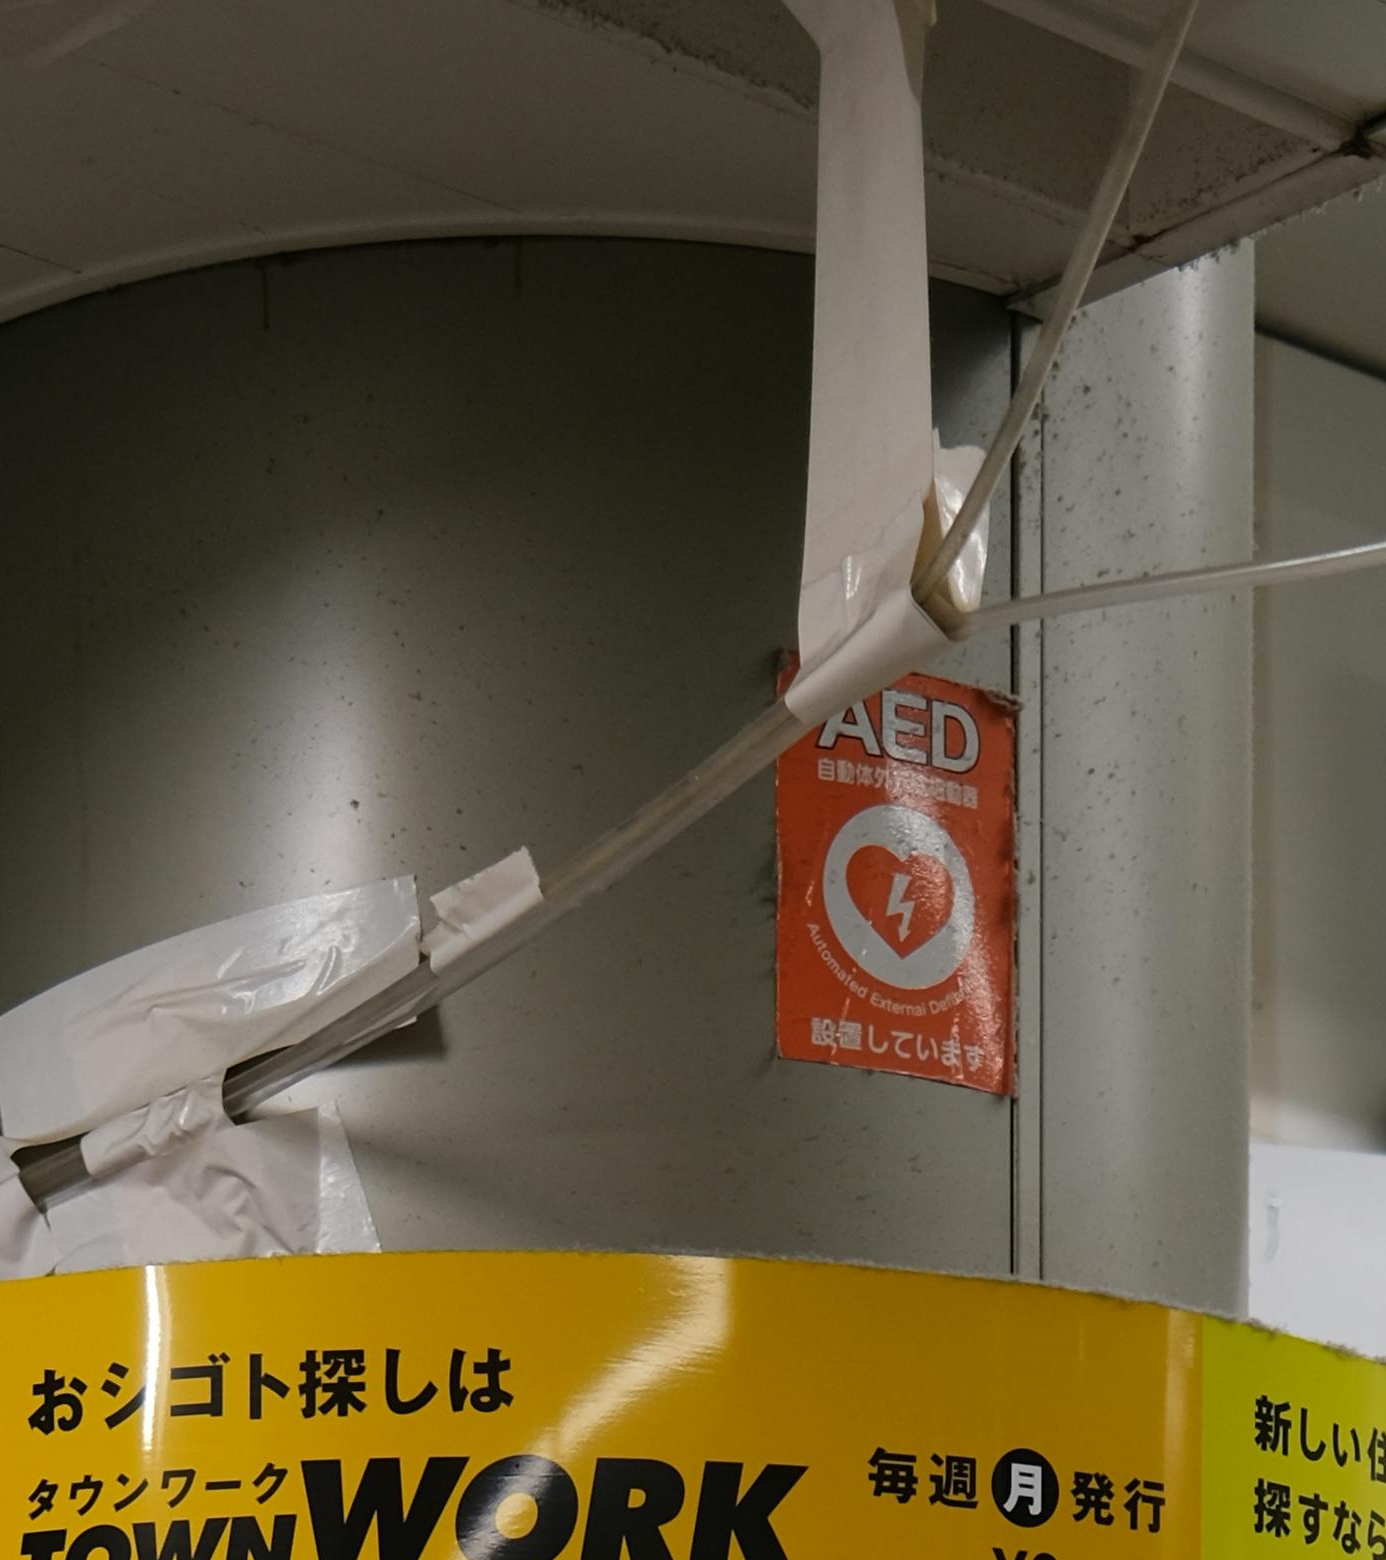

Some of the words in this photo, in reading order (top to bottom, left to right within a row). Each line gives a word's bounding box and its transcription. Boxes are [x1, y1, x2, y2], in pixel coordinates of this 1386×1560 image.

[815, 689, 981, 774] AED
[807, 923, 868, 999] Automated
[870, 992, 927, 1017] External
[811, 1016, 982, 1072] 設置しています
[28, 1348, 513, 1434] おシゴト探しは
[28, 1462, 289, 1518] タウンワーク
[866, 1448, 1165, 1532] 毎週月発行
